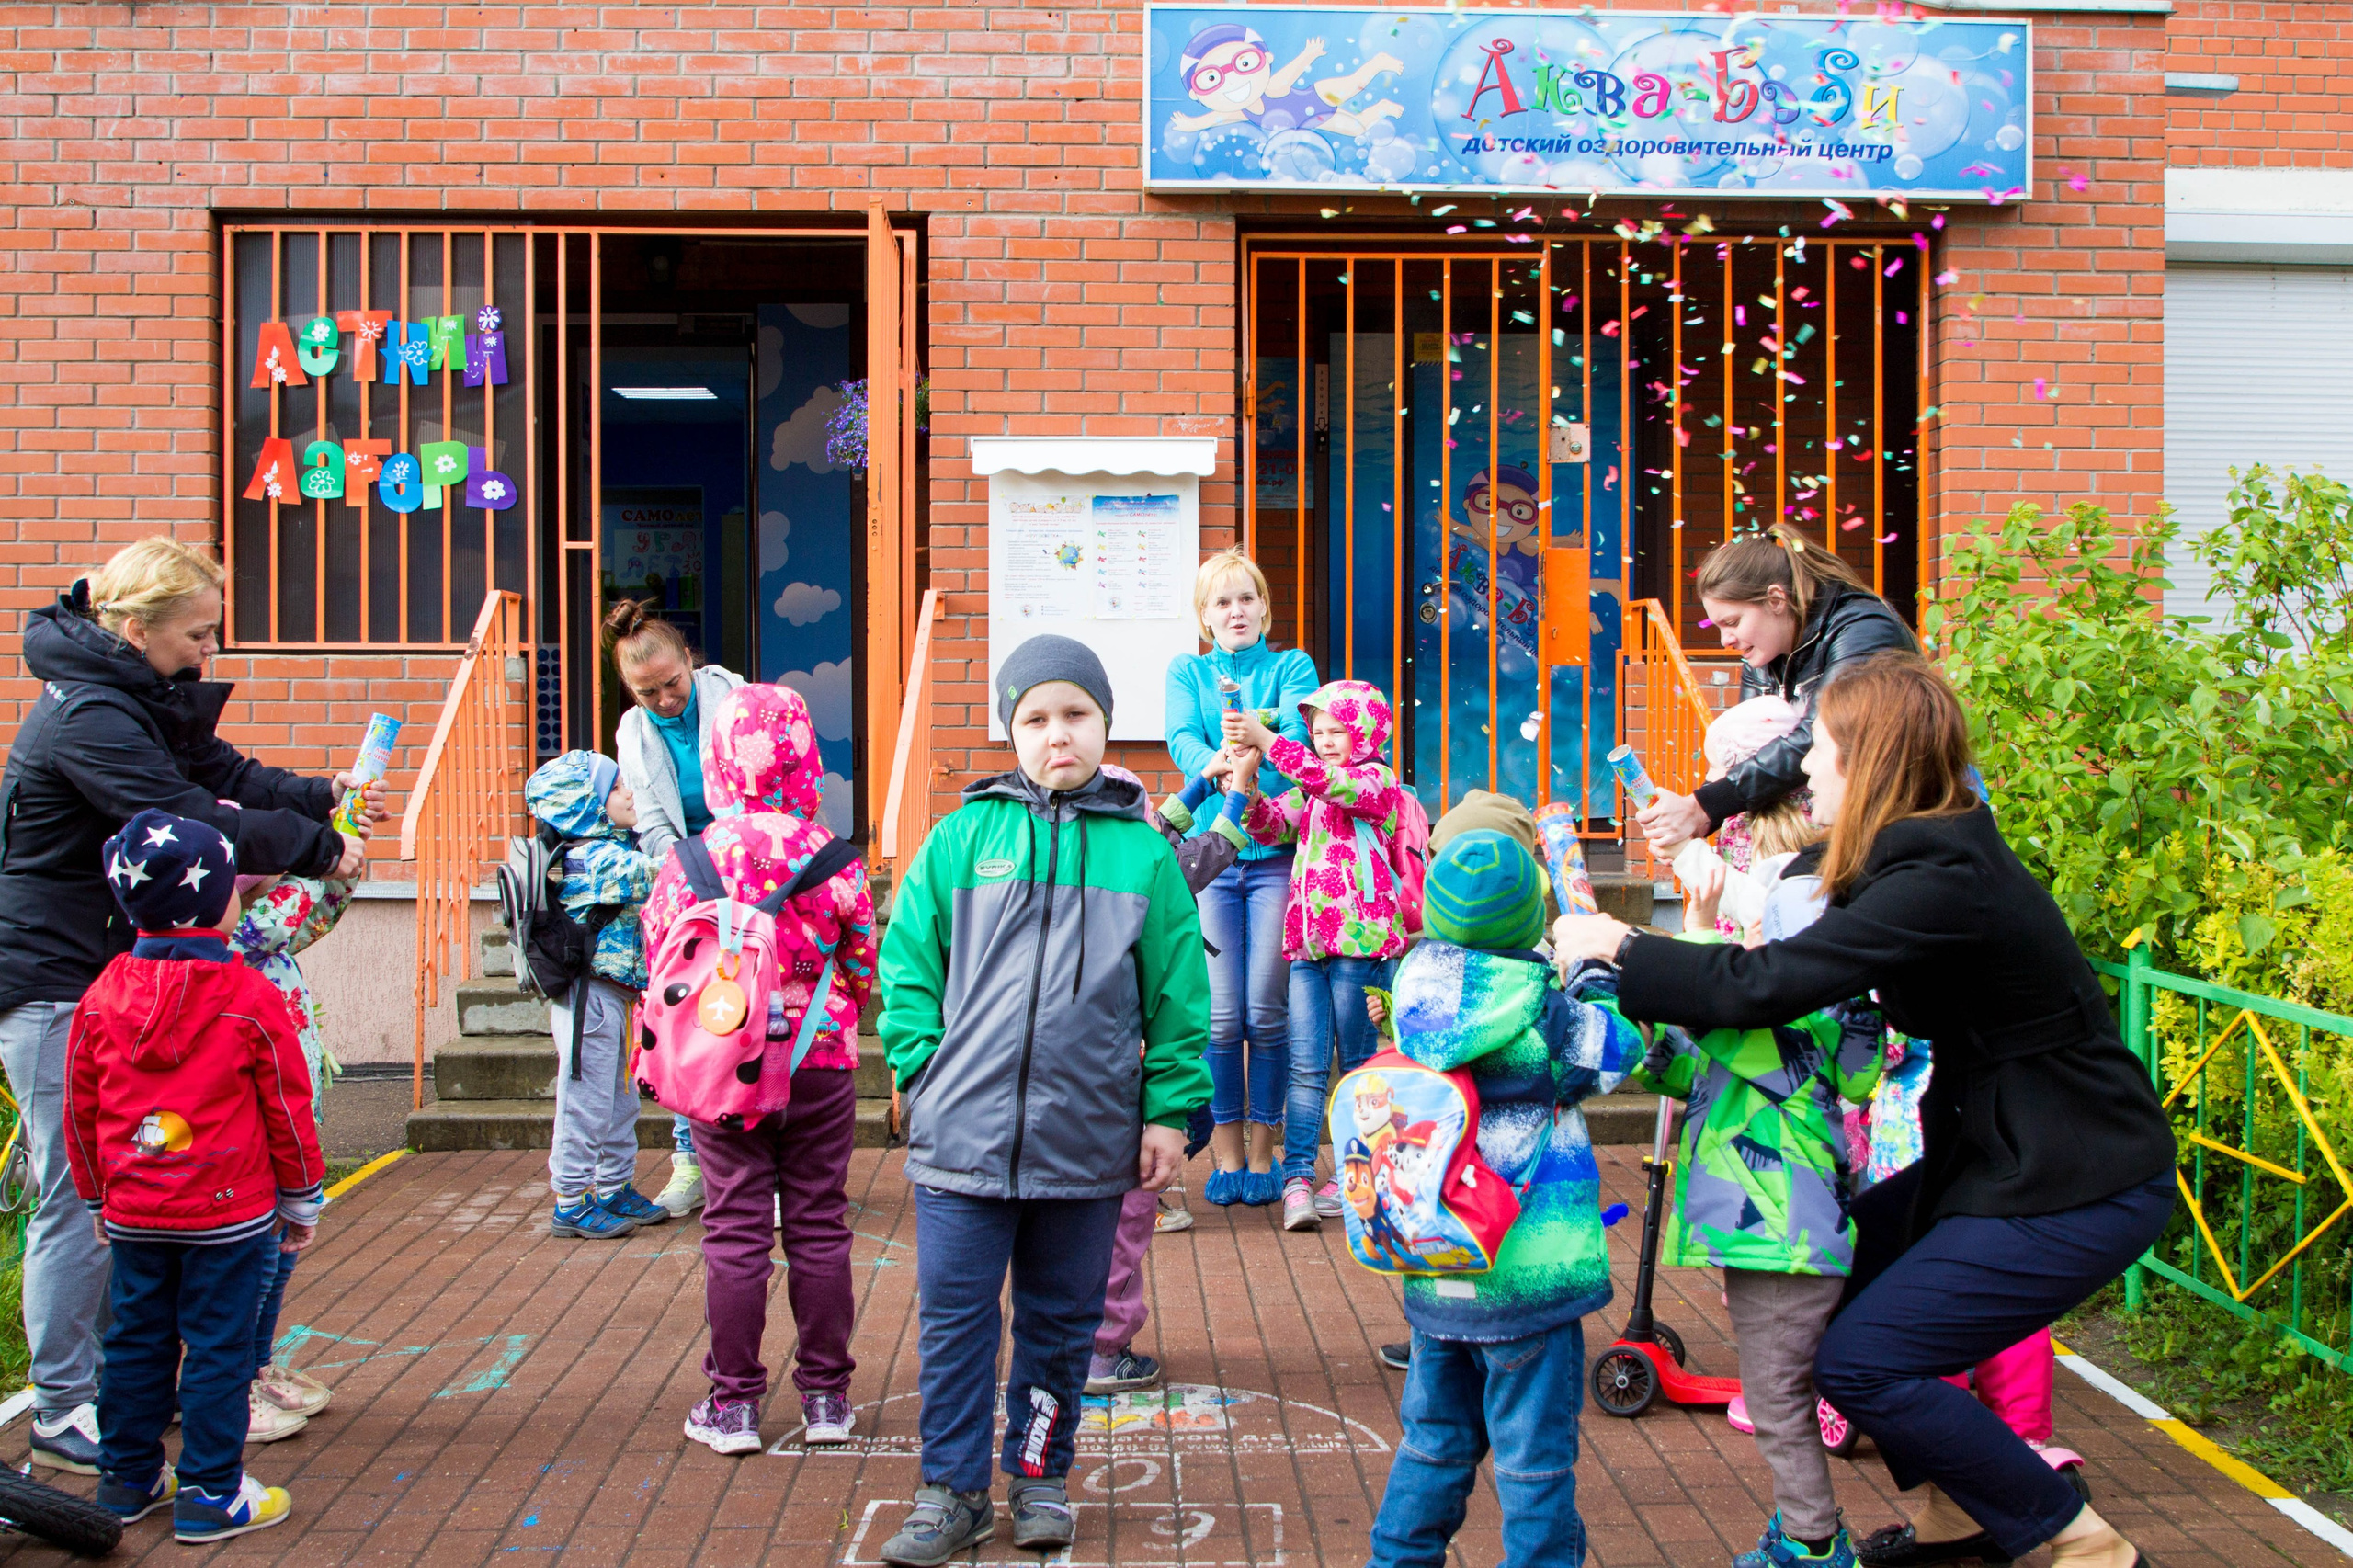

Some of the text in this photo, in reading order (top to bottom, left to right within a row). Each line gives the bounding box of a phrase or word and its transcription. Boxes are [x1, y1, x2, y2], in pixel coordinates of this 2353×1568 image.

[1460, 38, 1904, 131] Аква-Бэби
[1461, 133, 1571, 154] детский
[1818, 142, 1893, 164] центр
[1258, 462, 1300, 475] 21-0
[1437, 542, 1539, 636] Аква-Бэ
[1461, 590, 1530, 651] оздоротельный
[1024, 1412, 1051, 1468] RACING
